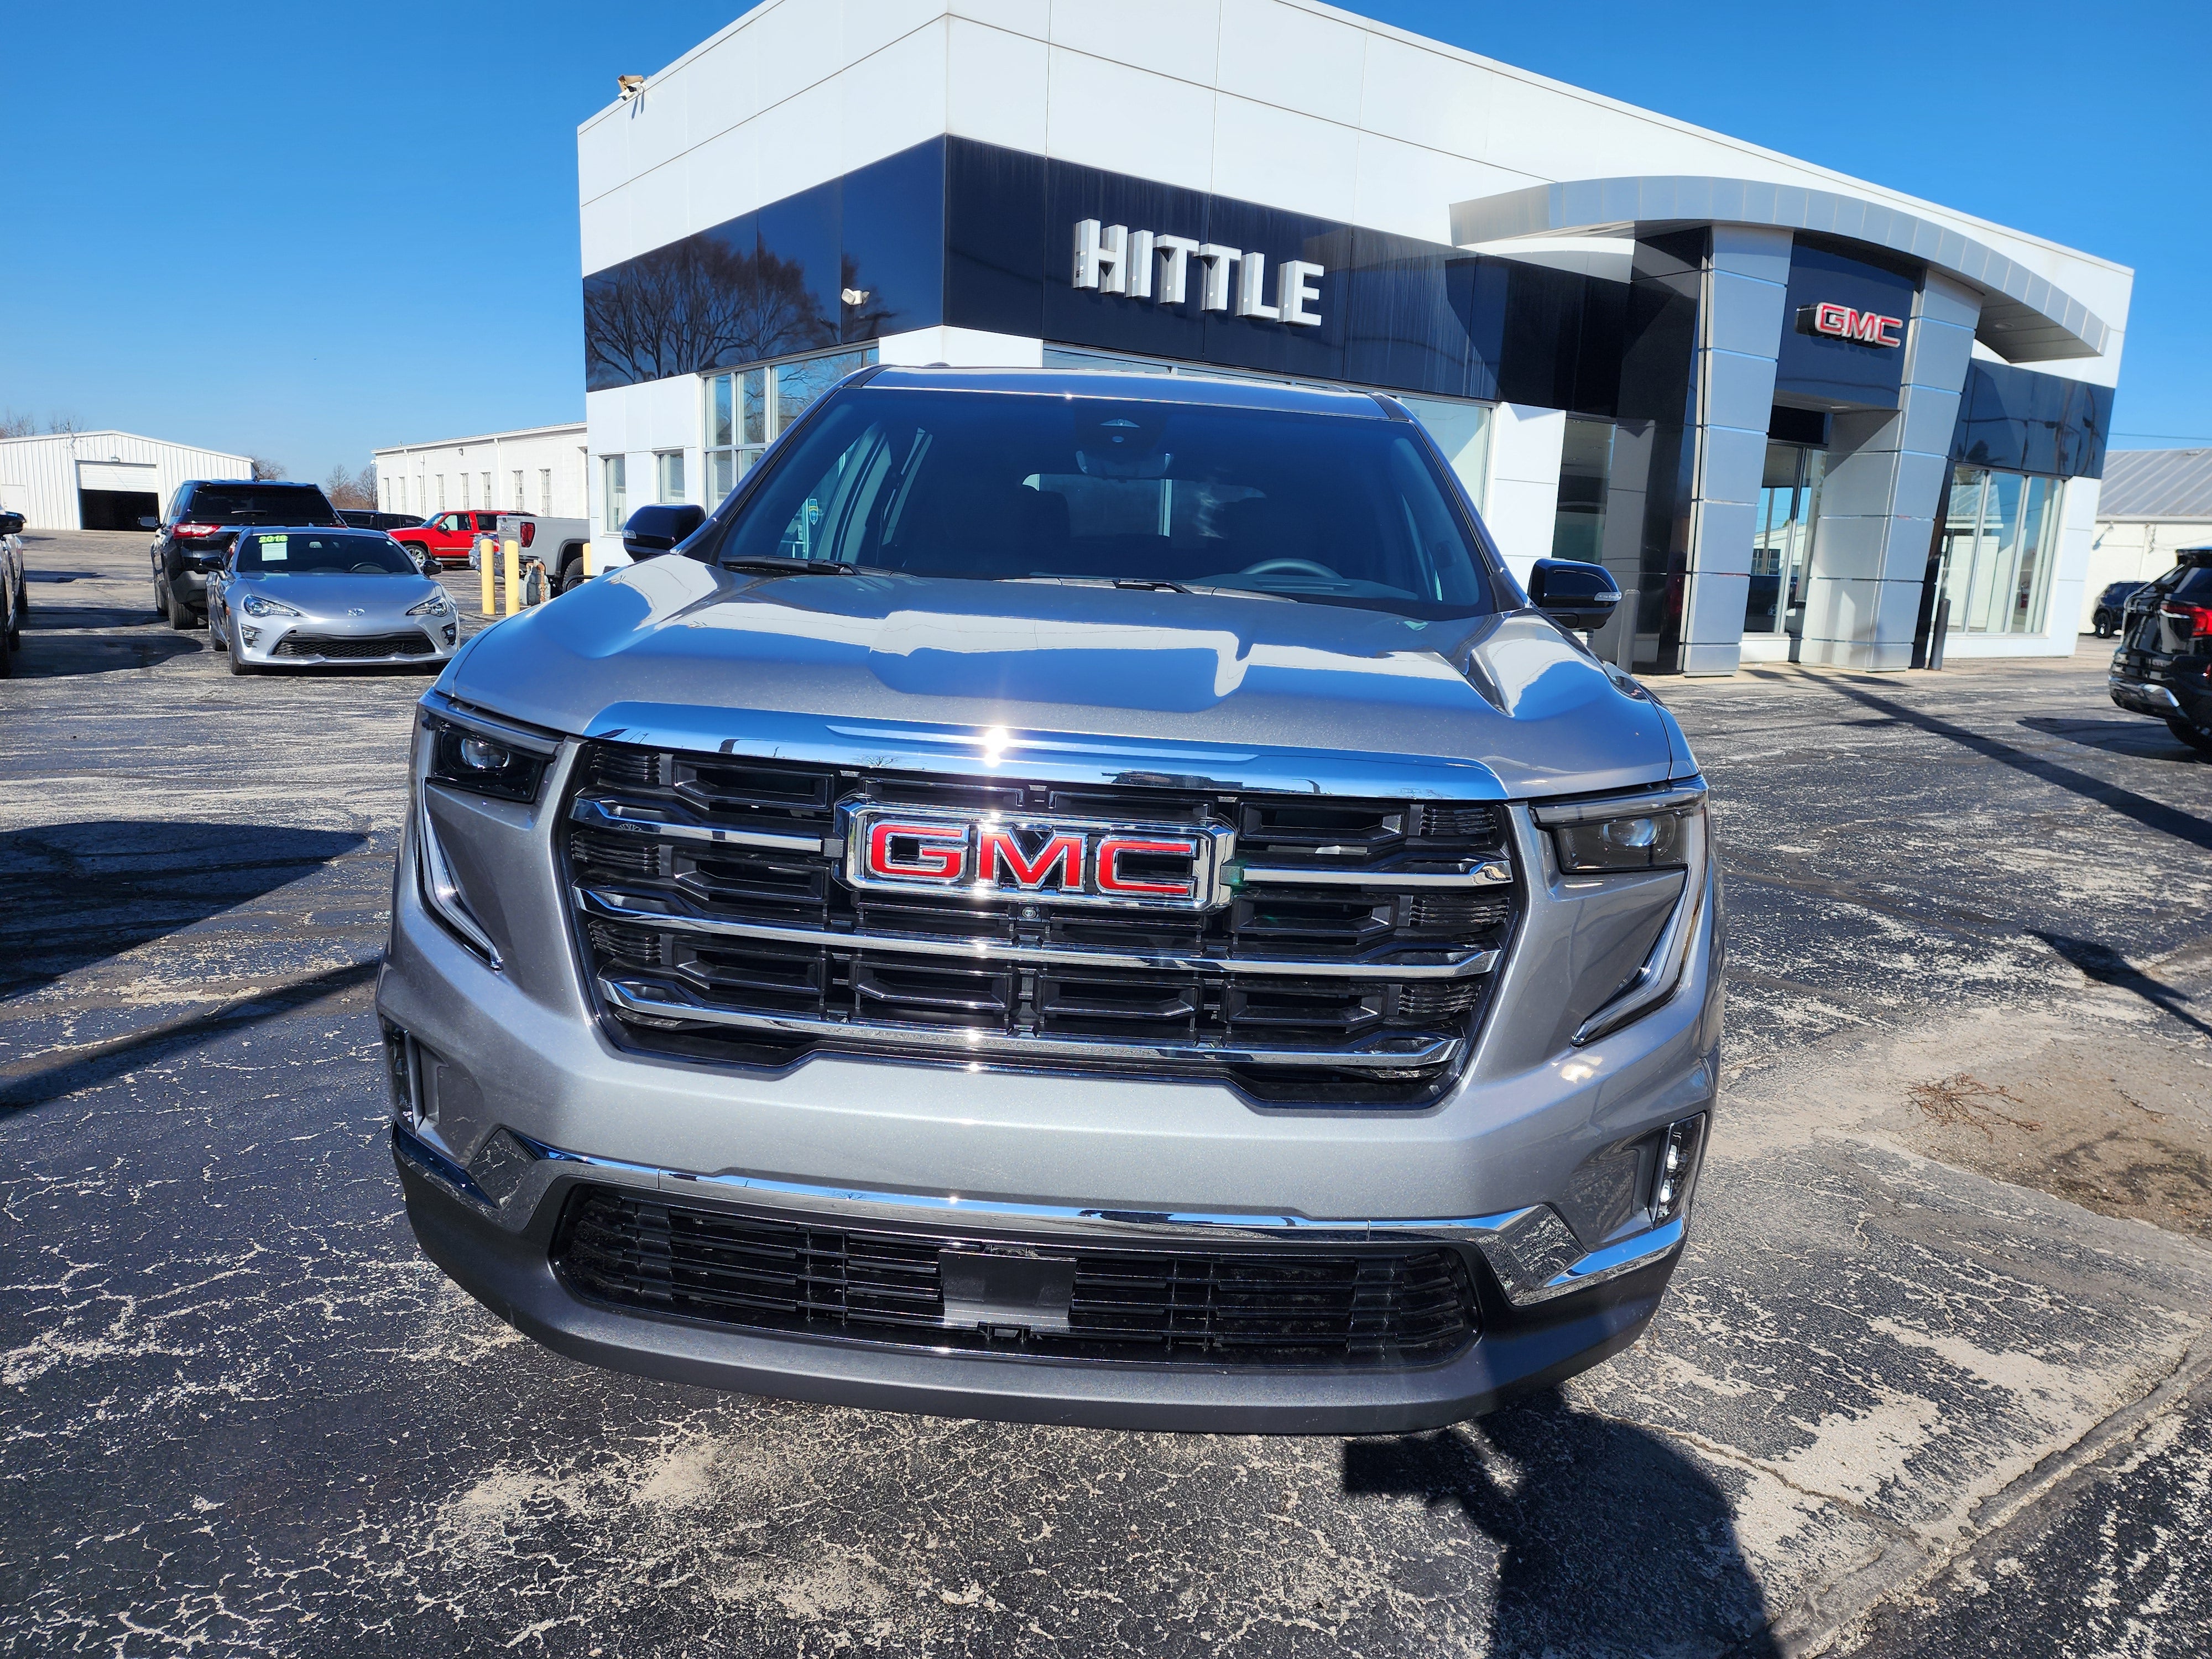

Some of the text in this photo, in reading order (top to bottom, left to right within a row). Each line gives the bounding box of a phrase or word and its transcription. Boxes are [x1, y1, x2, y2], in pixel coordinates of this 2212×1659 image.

[1073, 218, 1324, 326] HITTLE
[1815, 302, 1903, 348] GMC
[258, 535, 288, 543] 2018
[867, 820, 1198, 899] GMC
